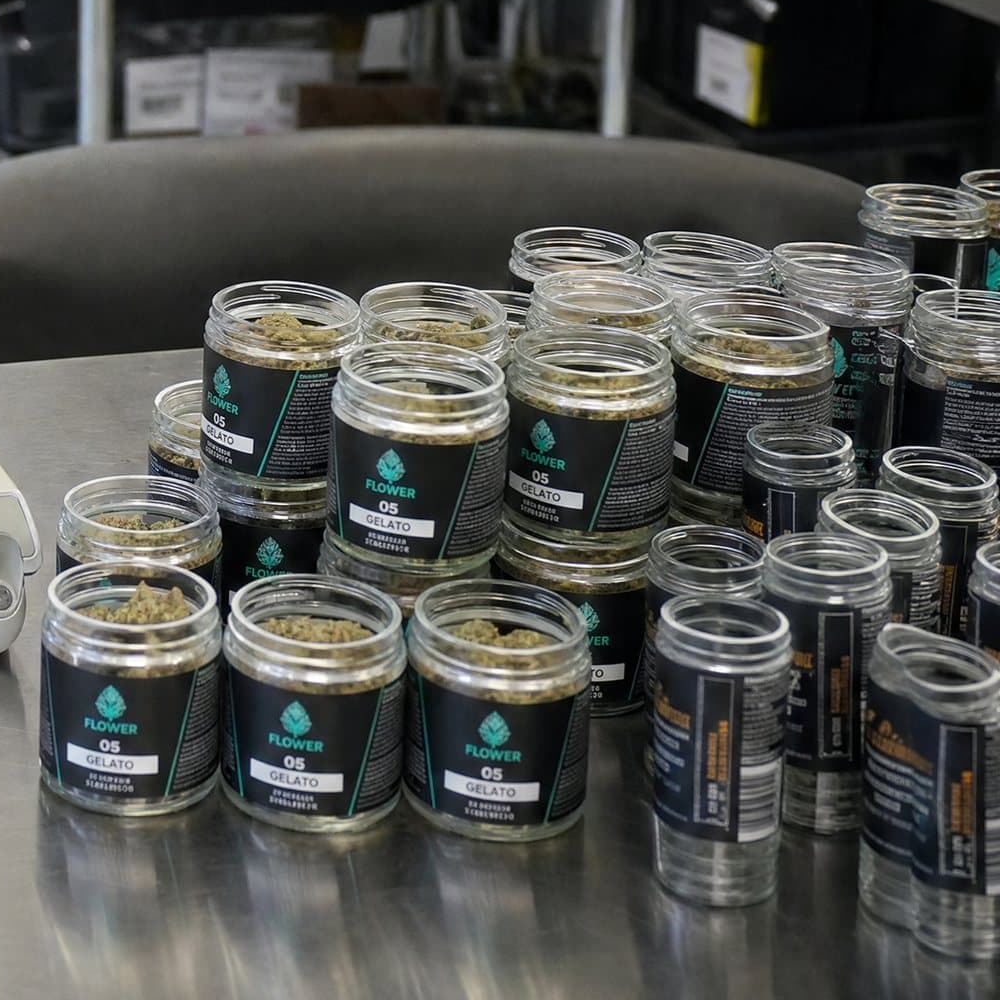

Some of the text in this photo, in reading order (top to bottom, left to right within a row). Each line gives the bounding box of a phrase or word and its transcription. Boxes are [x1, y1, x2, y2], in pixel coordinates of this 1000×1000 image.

[207, 391, 239, 415] FLOWER
[213, 413, 226, 427] 05
[206, 424, 234, 446] GELATO
[519, 448, 566, 471] FLOWER
[532, 470, 549, 484] 05
[365, 478, 416, 499] FLOWER
[521, 482, 561, 502] GELATO
[379, 500, 399, 515] 05
[366, 514, 411, 532] GELATO
[84, 717, 138, 735] FLOWER
[99, 739, 121, 753] 05
[268, 732, 324, 752] FLOWER
[465, 743, 522, 762] FLOWER
[86, 754, 135, 771] GELATO
[283, 755, 306, 770] 05
[269, 770, 319, 788] GELATO
[480, 766, 504, 781] 05
[465, 782, 516, 798] GELATO
